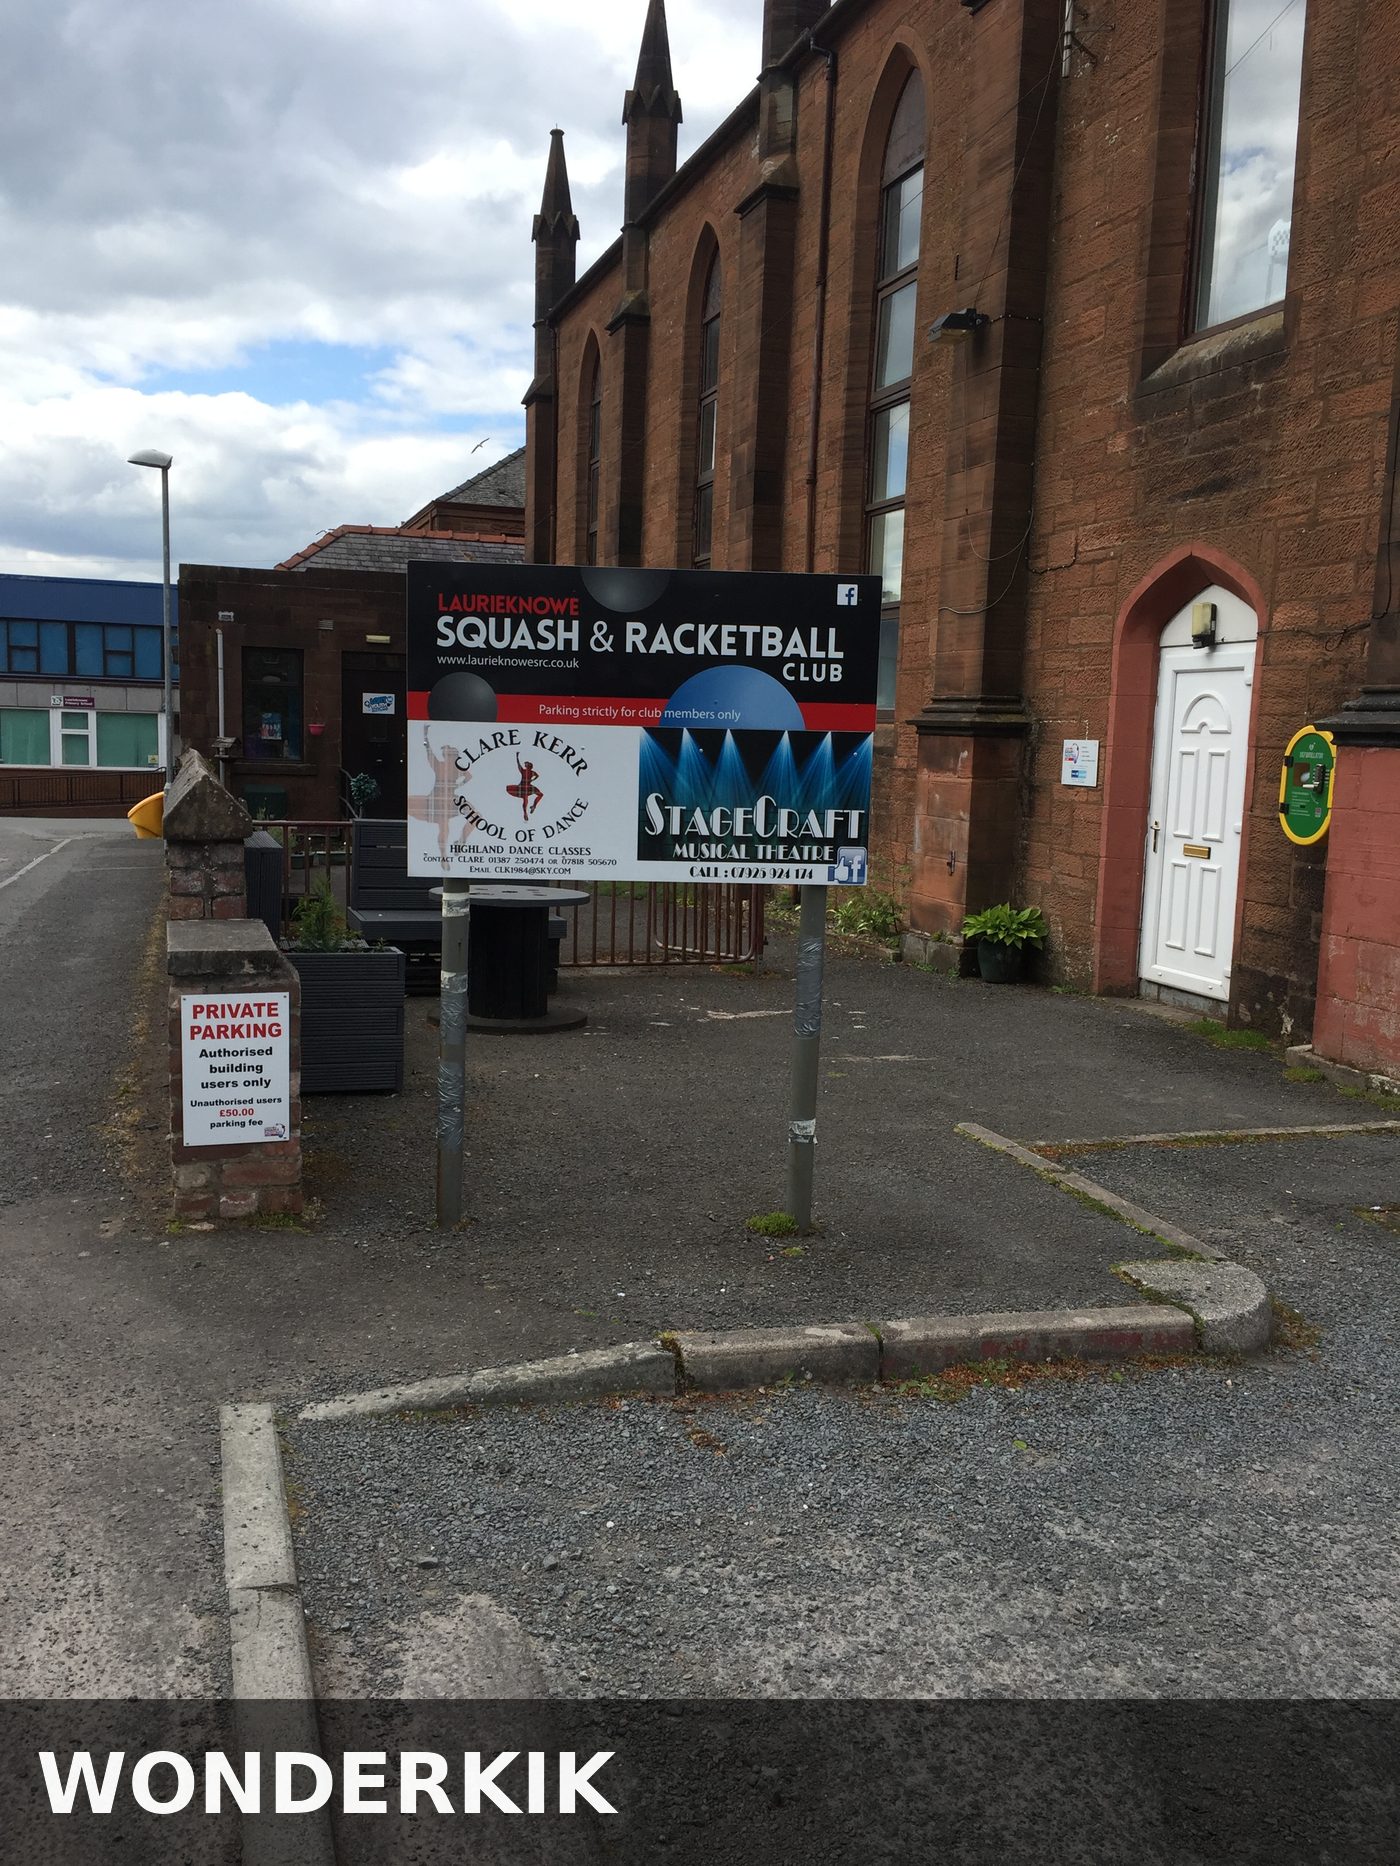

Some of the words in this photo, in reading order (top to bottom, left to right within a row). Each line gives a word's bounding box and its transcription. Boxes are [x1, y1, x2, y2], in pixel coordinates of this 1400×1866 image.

[437, 593, 579, 616] LAURIEKNOWE
[436, 615, 579, 652] SQUASH
[589, 620, 614, 653] &
[625, 621, 844, 659] RACKETBALL
[437, 655, 580, 669] www.laurieknowesrc.co.uk
[782, 662, 844, 683] CLUB
[538, 704, 580, 719] Parking
[581, 706, 619, 720] strictly
[620, 706, 637, 718] for
[638, 707, 662, 719] club
[664, 708, 716, 720] members
[717, 709, 741, 723] only
[454, 729, 521, 772] CLARE
[532, 730, 588, 777] KERR
[453, 795, 507, 841] SCHOOL
[515, 828, 536, 842] OF
[542, 798, 589, 839] DANCE
[450, 844, 504, 854] HIGHLAND
[509, 846, 544, 855] DANCE
[548, 846, 592, 856] CLASSES
[672, 842, 751, 860] MUSICAL
[754, 844, 834, 862] THEATRE
[457, 855, 485, 864] CLARE
[488, 856, 512, 864] 01387
[514, 857, 544, 865] 250474
[561, 858, 585, 866] 07818
[587, 858, 618, 867] 505670
[494, 866, 572, 876] CLK1984@SKY.COM
[689, 865, 722, 878] CALL
[730, 867, 767, 879] 07925
[769, 867, 791, 880] 924
[794, 867, 814, 880] 174
[192, 1002, 279, 1020] PRIVATE
[190, 1022, 282, 1041] PARKING
[199, 1046, 273, 1059] Authorised
[209, 1063, 264, 1075] building
[201, 1081, 239, 1090] users
[243, 1077, 271, 1089] only
[190, 1098, 253, 1108] Unauthorised
[256, 1097, 282, 1105] users
[219, 1108, 255, 1118] £50.00
[210, 1120, 246, 1130] parking
[248, 1118, 264, 1127] fee
